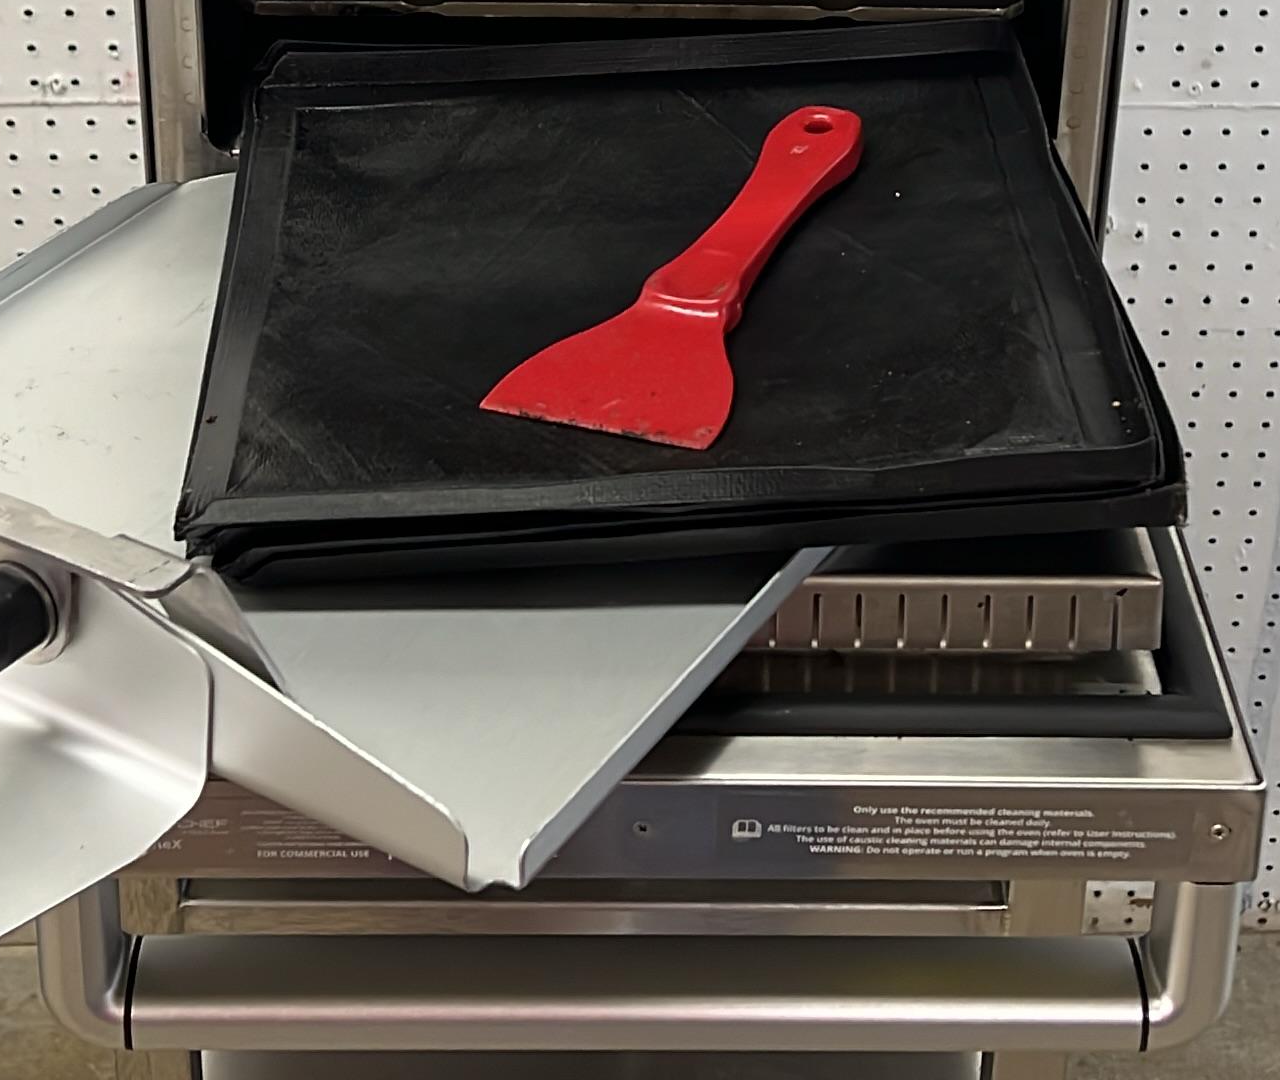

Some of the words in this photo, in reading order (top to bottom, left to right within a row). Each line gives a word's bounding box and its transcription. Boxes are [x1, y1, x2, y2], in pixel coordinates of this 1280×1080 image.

[853, 806, 878, 816] Only
[901, 806, 919, 815] the
[920, 807, 996, 816] recommended
[997, 808, 1040, 818] cleaning
[895, 816, 913, 824] The
[970, 818, 983, 826] be
[985, 818, 1024, 827] cleaned
[783, 824, 812, 833] filters
[814, 825, 825, 833] to
[827, 825, 840, 833] be
[841, 825, 869, 834] clean
[871, 826, 890, 834] and
[904, 827, 931, 836] place
[933, 827, 966, 836] before
[968, 829, 995, 838] using
[998, 828, 1014, 836] the
[1016, 829, 1041, 837] oven
[1073, 830, 1084, 838] to
[1086, 830, 1109, 838] User
[796, 834, 815, 843] The
[837, 835, 847, 843] of
[849, 836, 883, 844] caustic
[886, 836, 928, 846] cleaning
[930, 837, 977, 846] materials
[979, 838, 997, 846] can
[999, 838, 1039, 848] damage
[1041, 839, 1081, 848] internal
[257, 850, 278, 858] FOR
[280, 850, 347, 858] COMMERCIAL
[350, 850, 370, 858] USE
[866, 846, 881, 854] Do
[883, 846, 900, 854] not
[902, 847, 941, 856] operate
[957, 848, 974, 856] run
[976, 848, 983, 856] a
[985, 848, 1028, 858] program
[1030, 848, 1058, 857] when
[1060, 849, 1085, 857] oven
[1087, 849, 1095, 857] is
